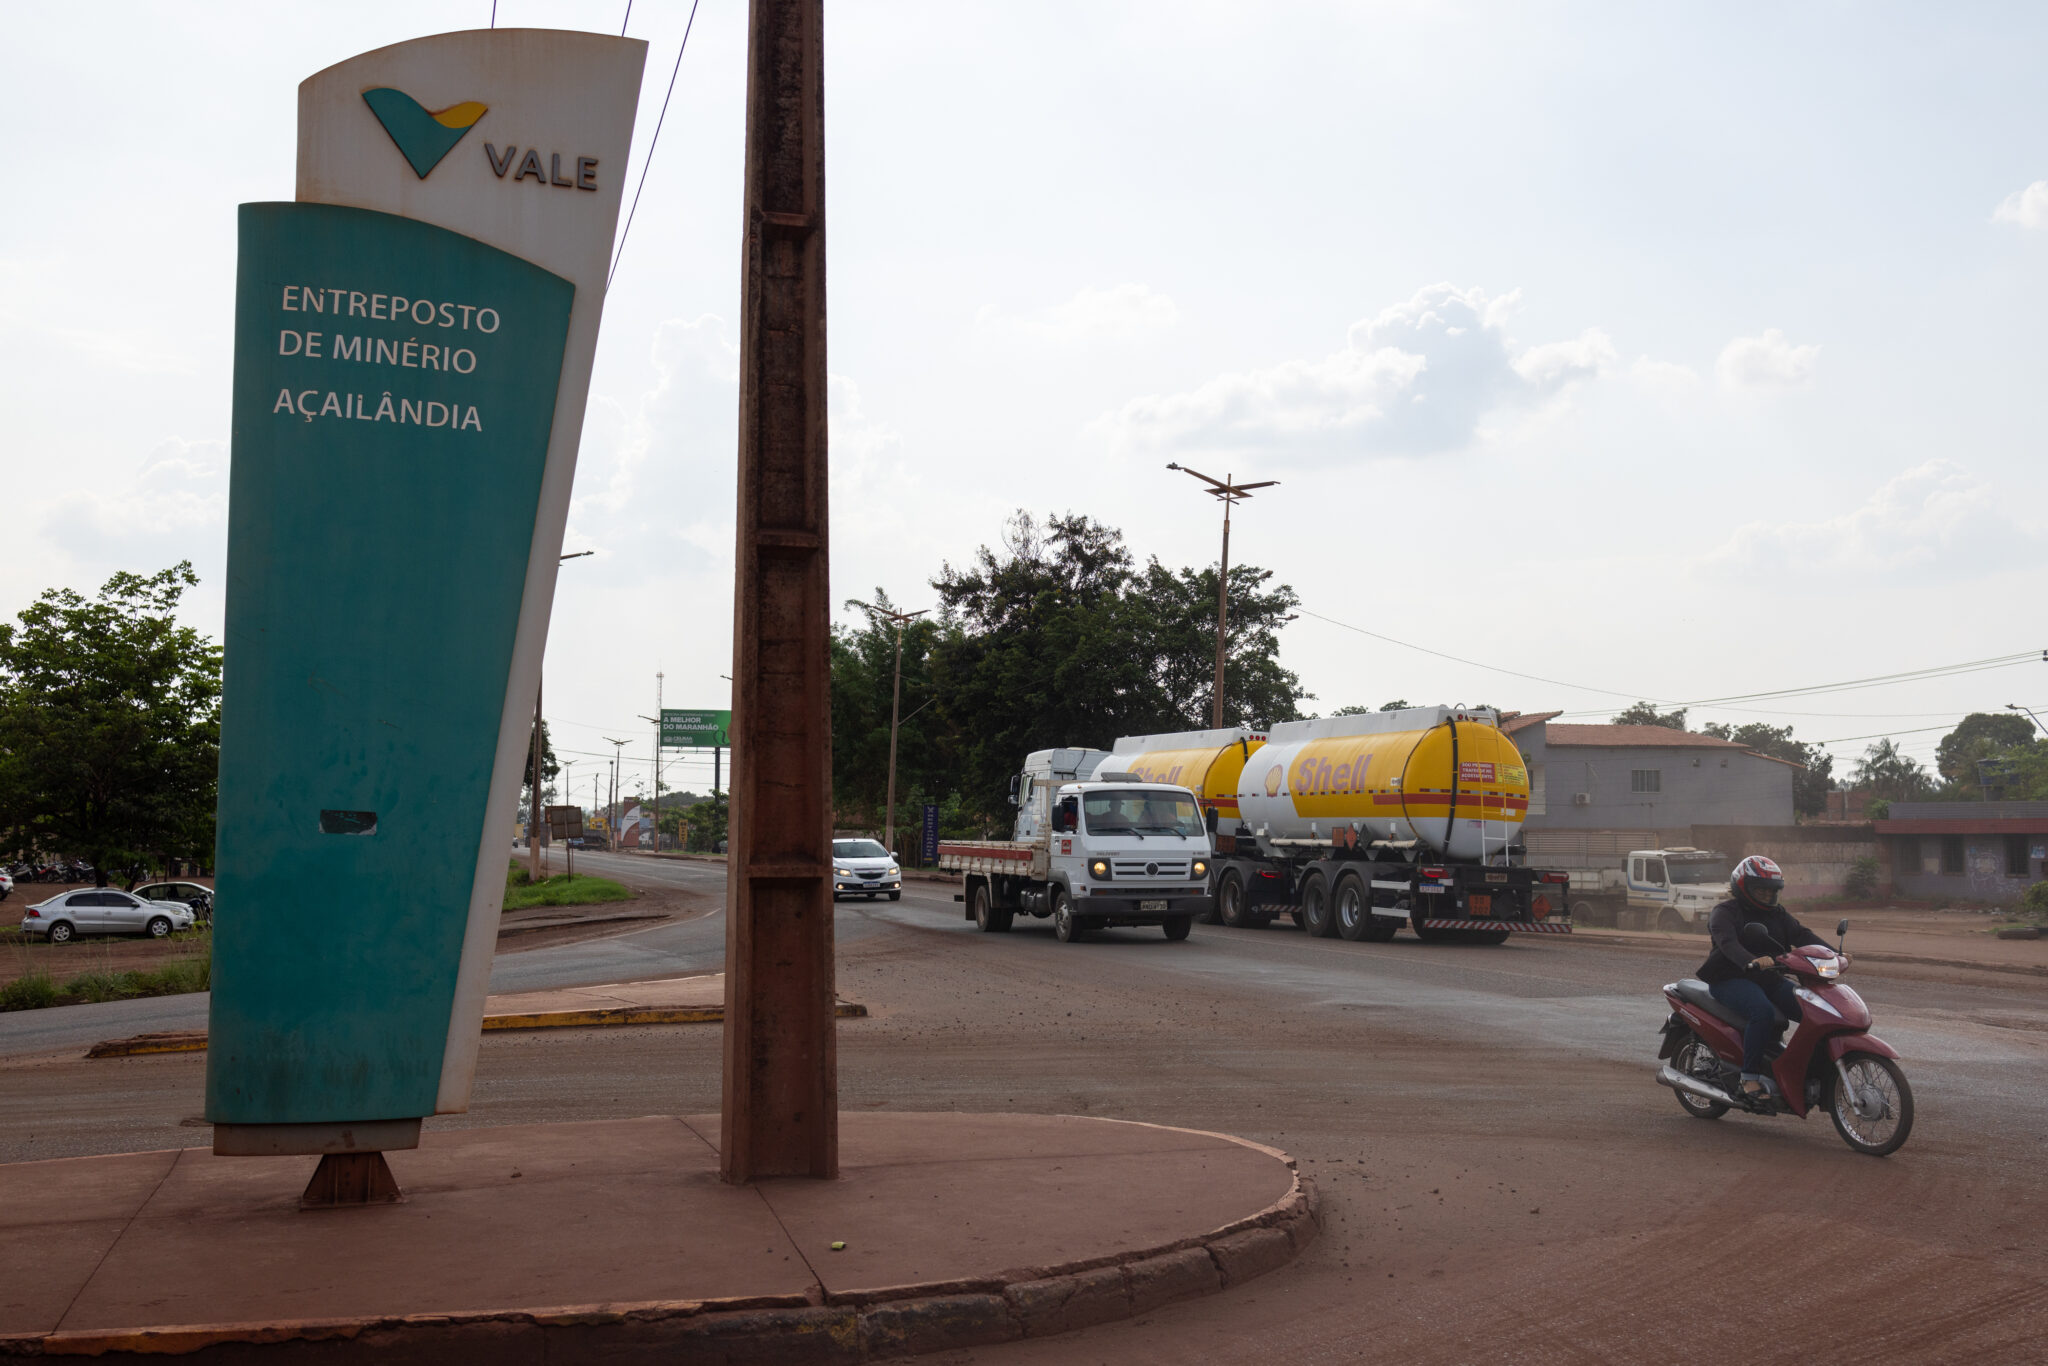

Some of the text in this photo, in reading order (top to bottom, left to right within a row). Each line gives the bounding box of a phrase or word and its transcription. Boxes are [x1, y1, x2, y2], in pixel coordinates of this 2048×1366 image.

[484, 143, 598, 191] VALE
[282, 285, 500, 334] ENTREPOSTO
[279, 330, 477, 374] DE MINÉRIO
[273, 388, 482, 432] AÇAILÂNDIA
[675, 723, 719, 731] MARANHÃO
[1296, 754, 1374, 791] Shell
